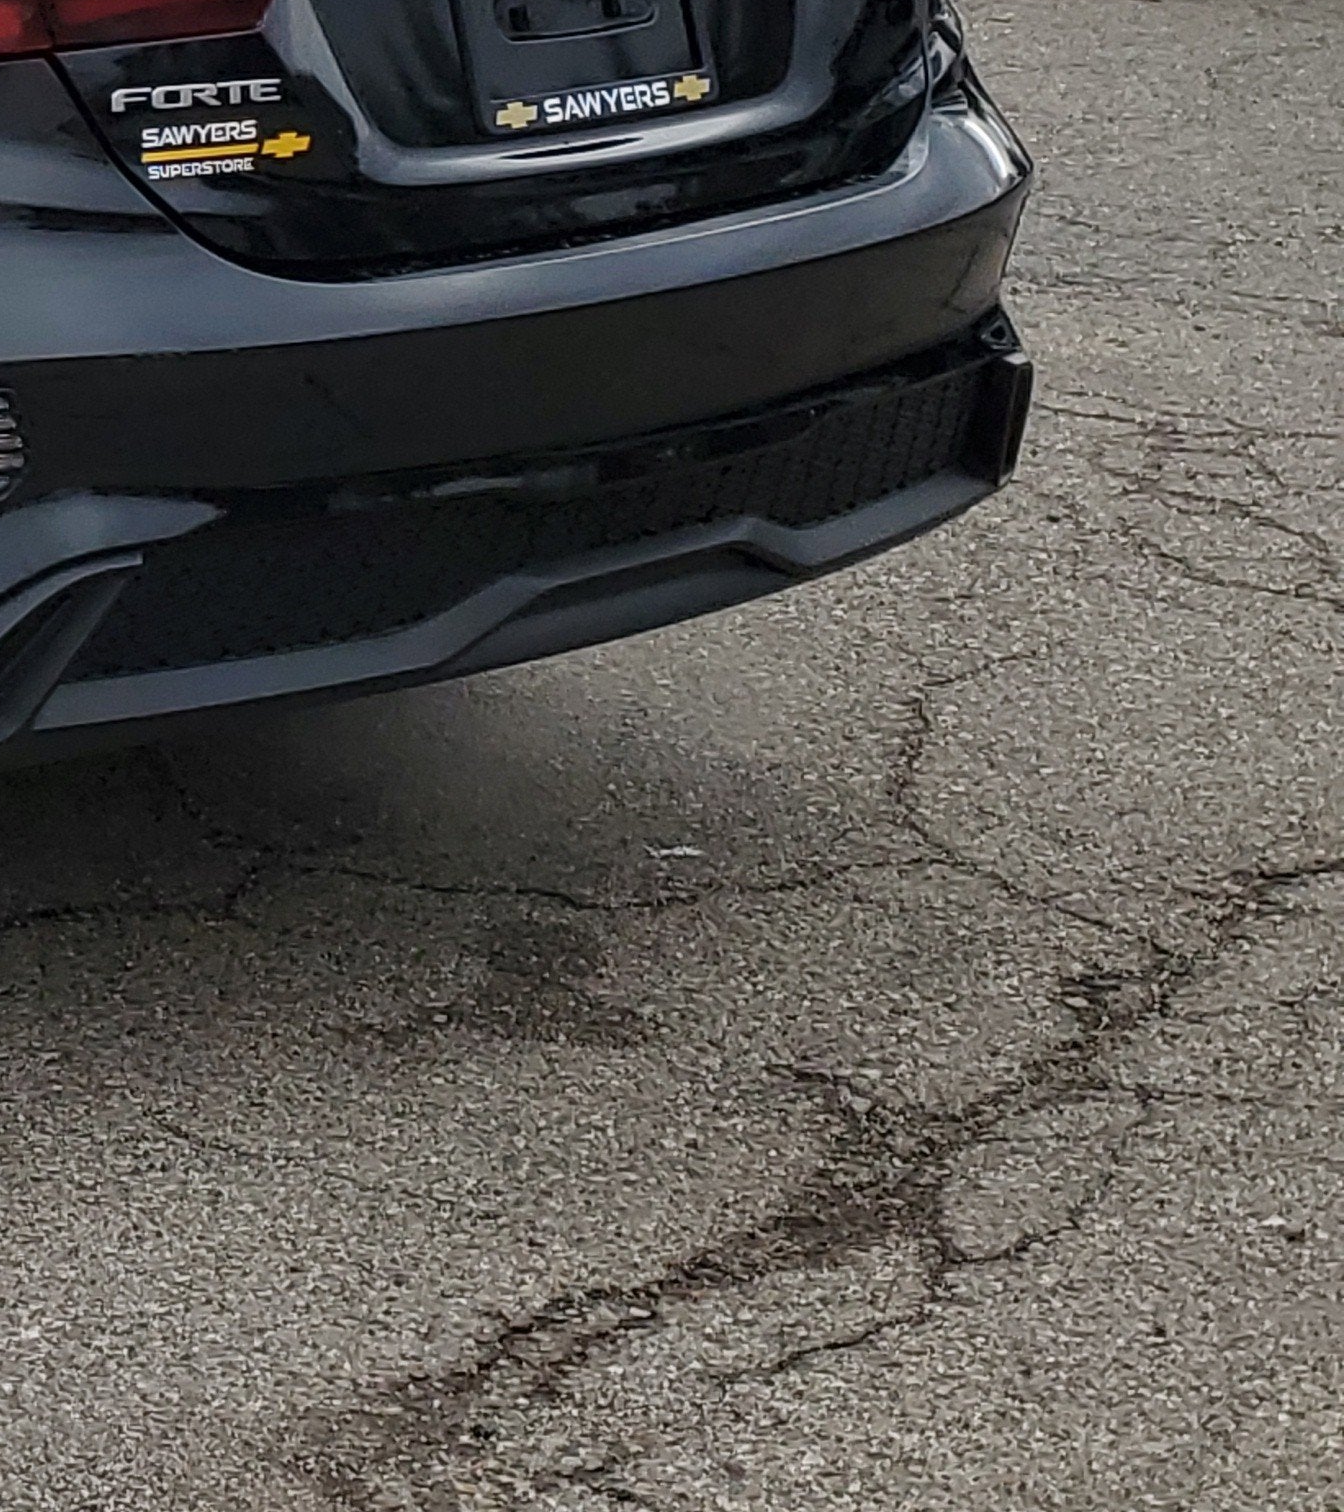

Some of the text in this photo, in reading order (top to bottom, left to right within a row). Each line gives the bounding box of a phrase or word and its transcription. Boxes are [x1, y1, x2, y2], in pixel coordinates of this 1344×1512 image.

[111, 78, 282, 113] FORTE
[543, 81, 670, 124] SAWYERS
[141, 119, 258, 149] SAWYERS
[148, 157, 255, 180] SUPERSTORE
